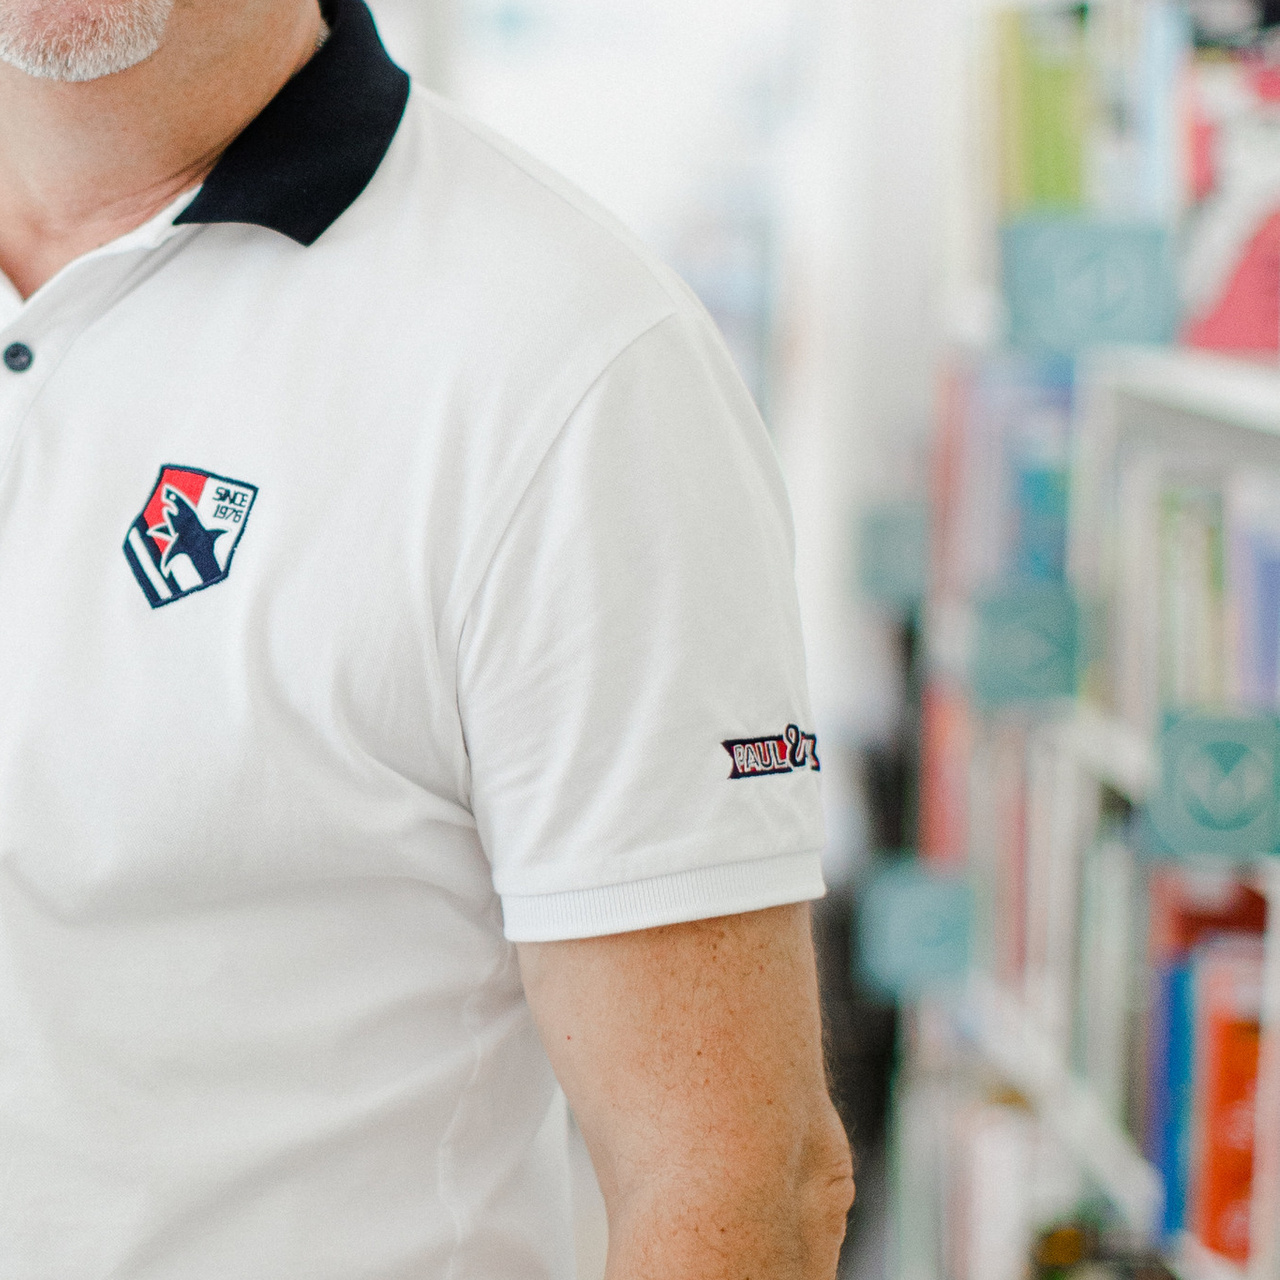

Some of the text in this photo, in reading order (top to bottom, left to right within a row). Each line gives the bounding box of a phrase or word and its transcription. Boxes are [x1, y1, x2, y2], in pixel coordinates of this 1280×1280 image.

[212, 486, 249, 508] SINCE
[212, 503, 244, 524] 1976
[734, 740, 788, 773] PAUL
